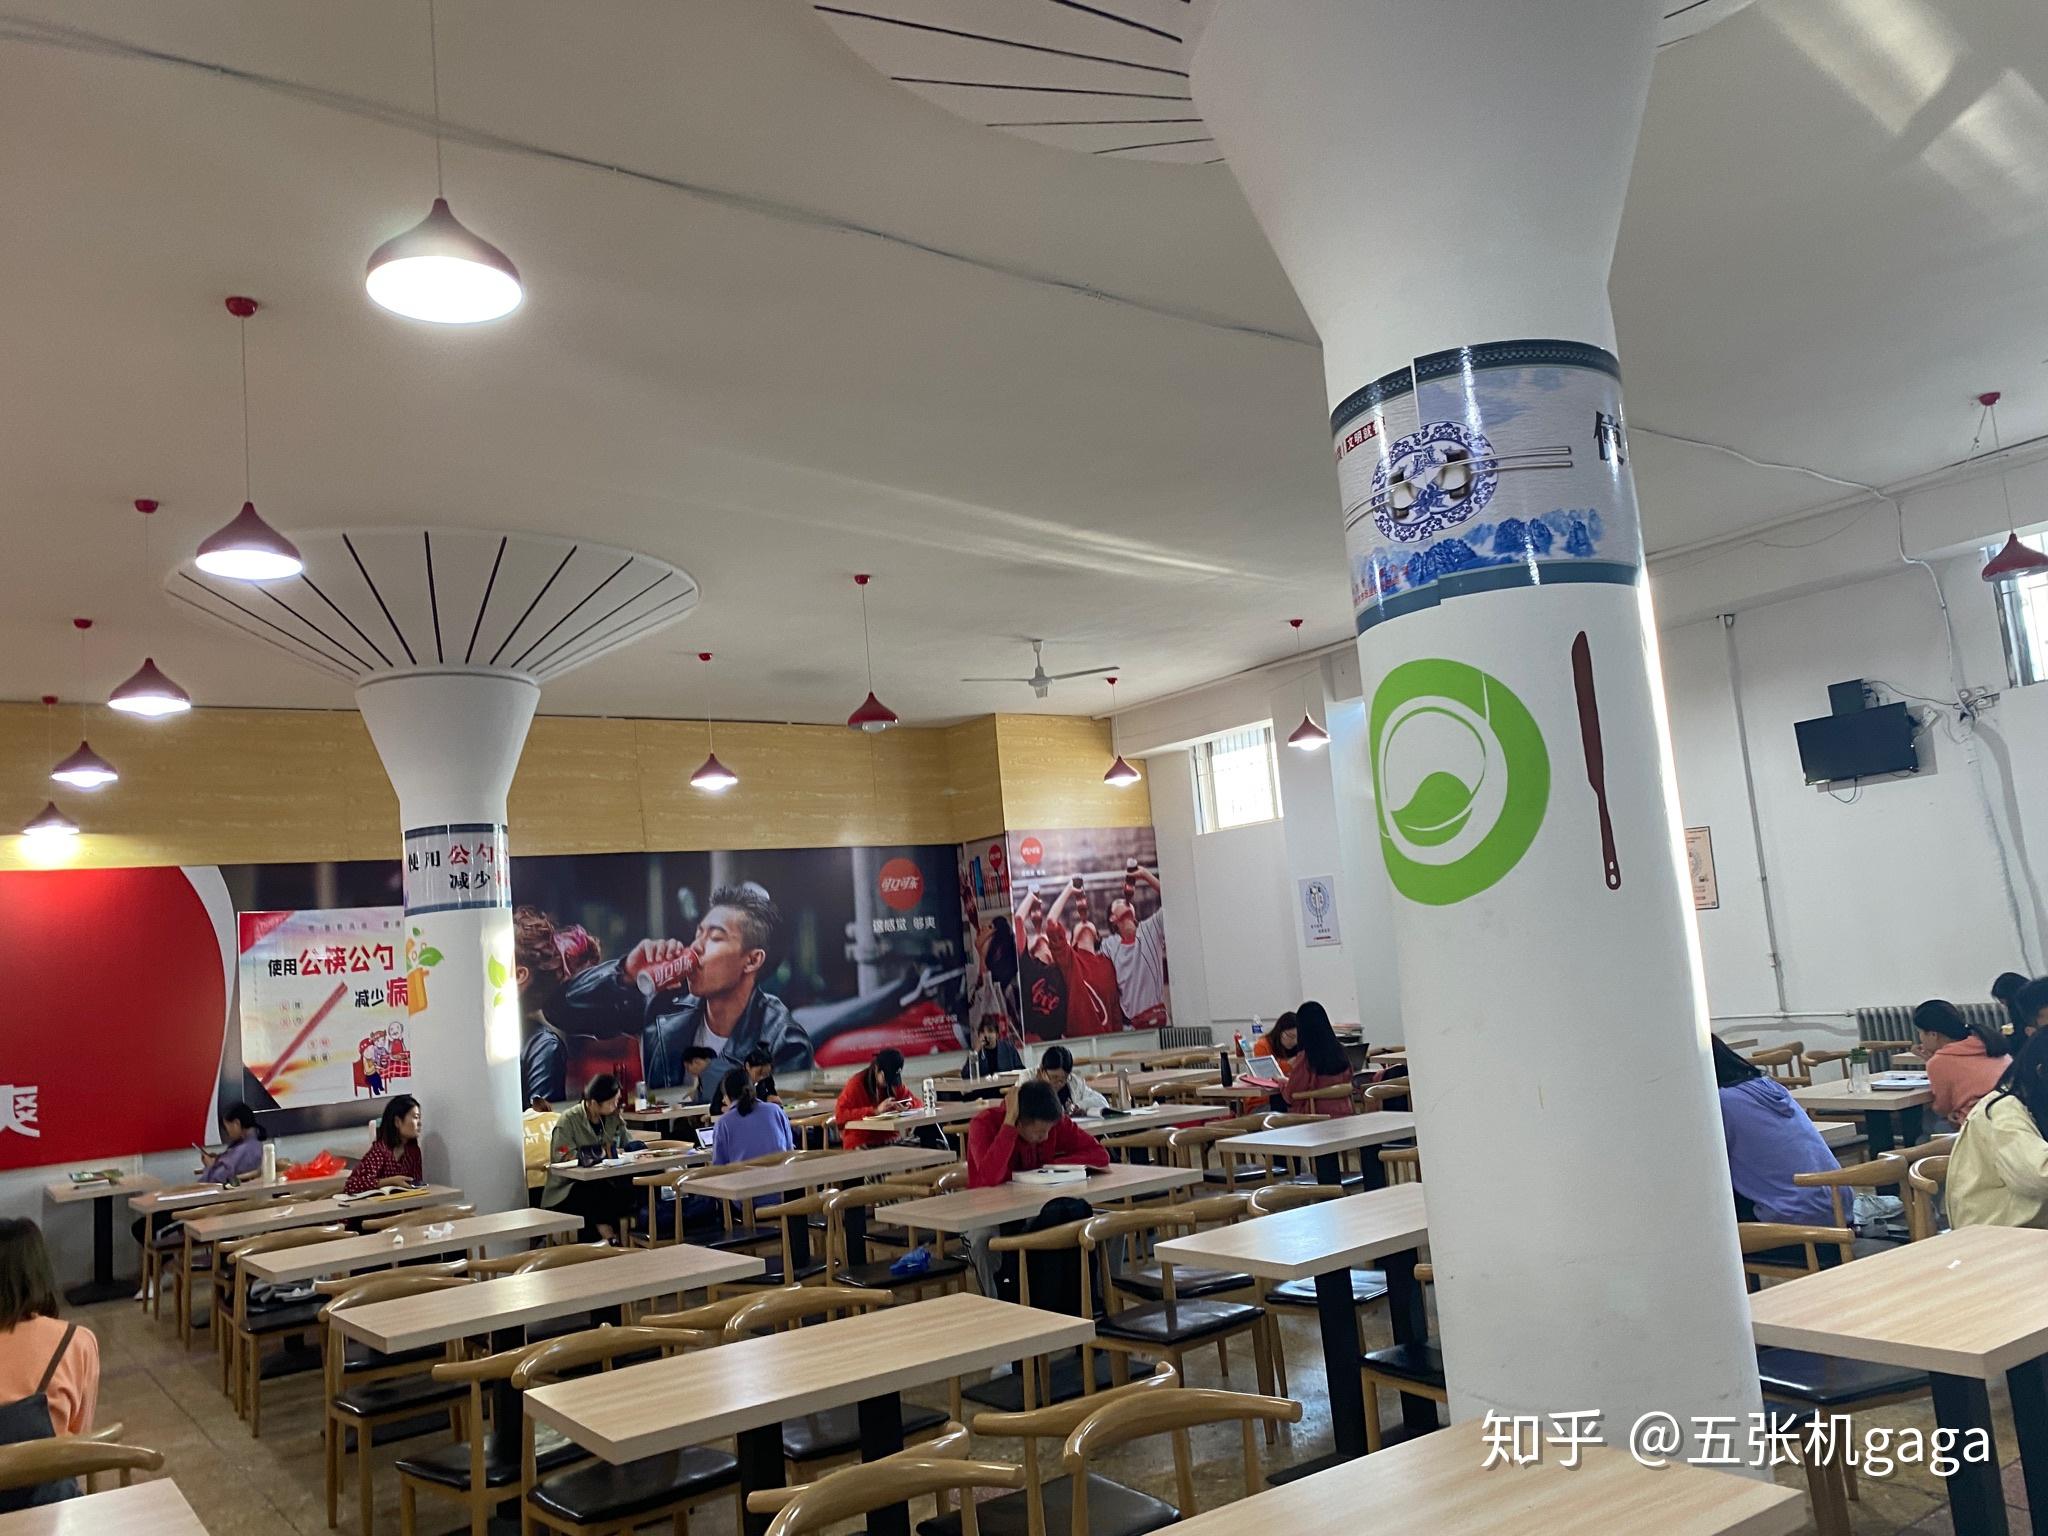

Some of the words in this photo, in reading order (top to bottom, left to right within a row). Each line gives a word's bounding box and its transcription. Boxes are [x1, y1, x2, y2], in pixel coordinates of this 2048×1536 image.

[268, 943, 394, 977] 使用公筷公勺
